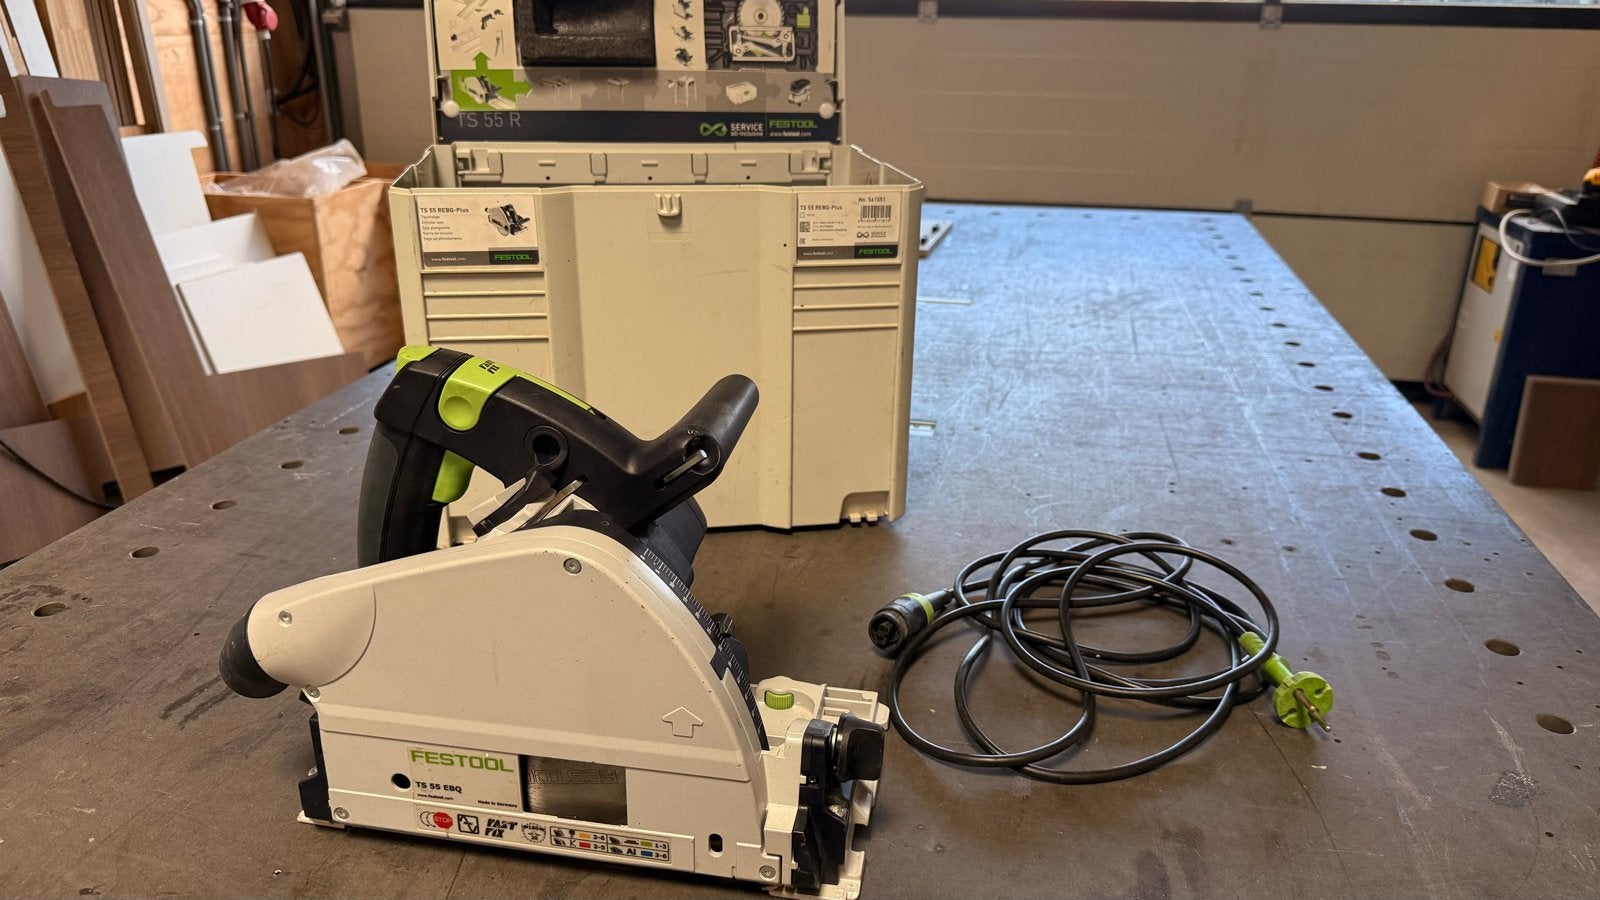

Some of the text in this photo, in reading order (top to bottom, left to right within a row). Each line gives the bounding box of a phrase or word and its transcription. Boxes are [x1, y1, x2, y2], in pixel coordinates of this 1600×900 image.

[458, 112, 521, 128] TS 55 R
[769, 120, 818, 128] FESTOOL
[730, 123, 763, 131] SERVICE
[410, 749, 515, 773] FESTOOL
[416, 781, 462, 794] TS 55 EBQ
[434, 815, 452, 824] STOP
[487, 818, 518, 830] FAST
[485, 827, 505, 838] FIX
